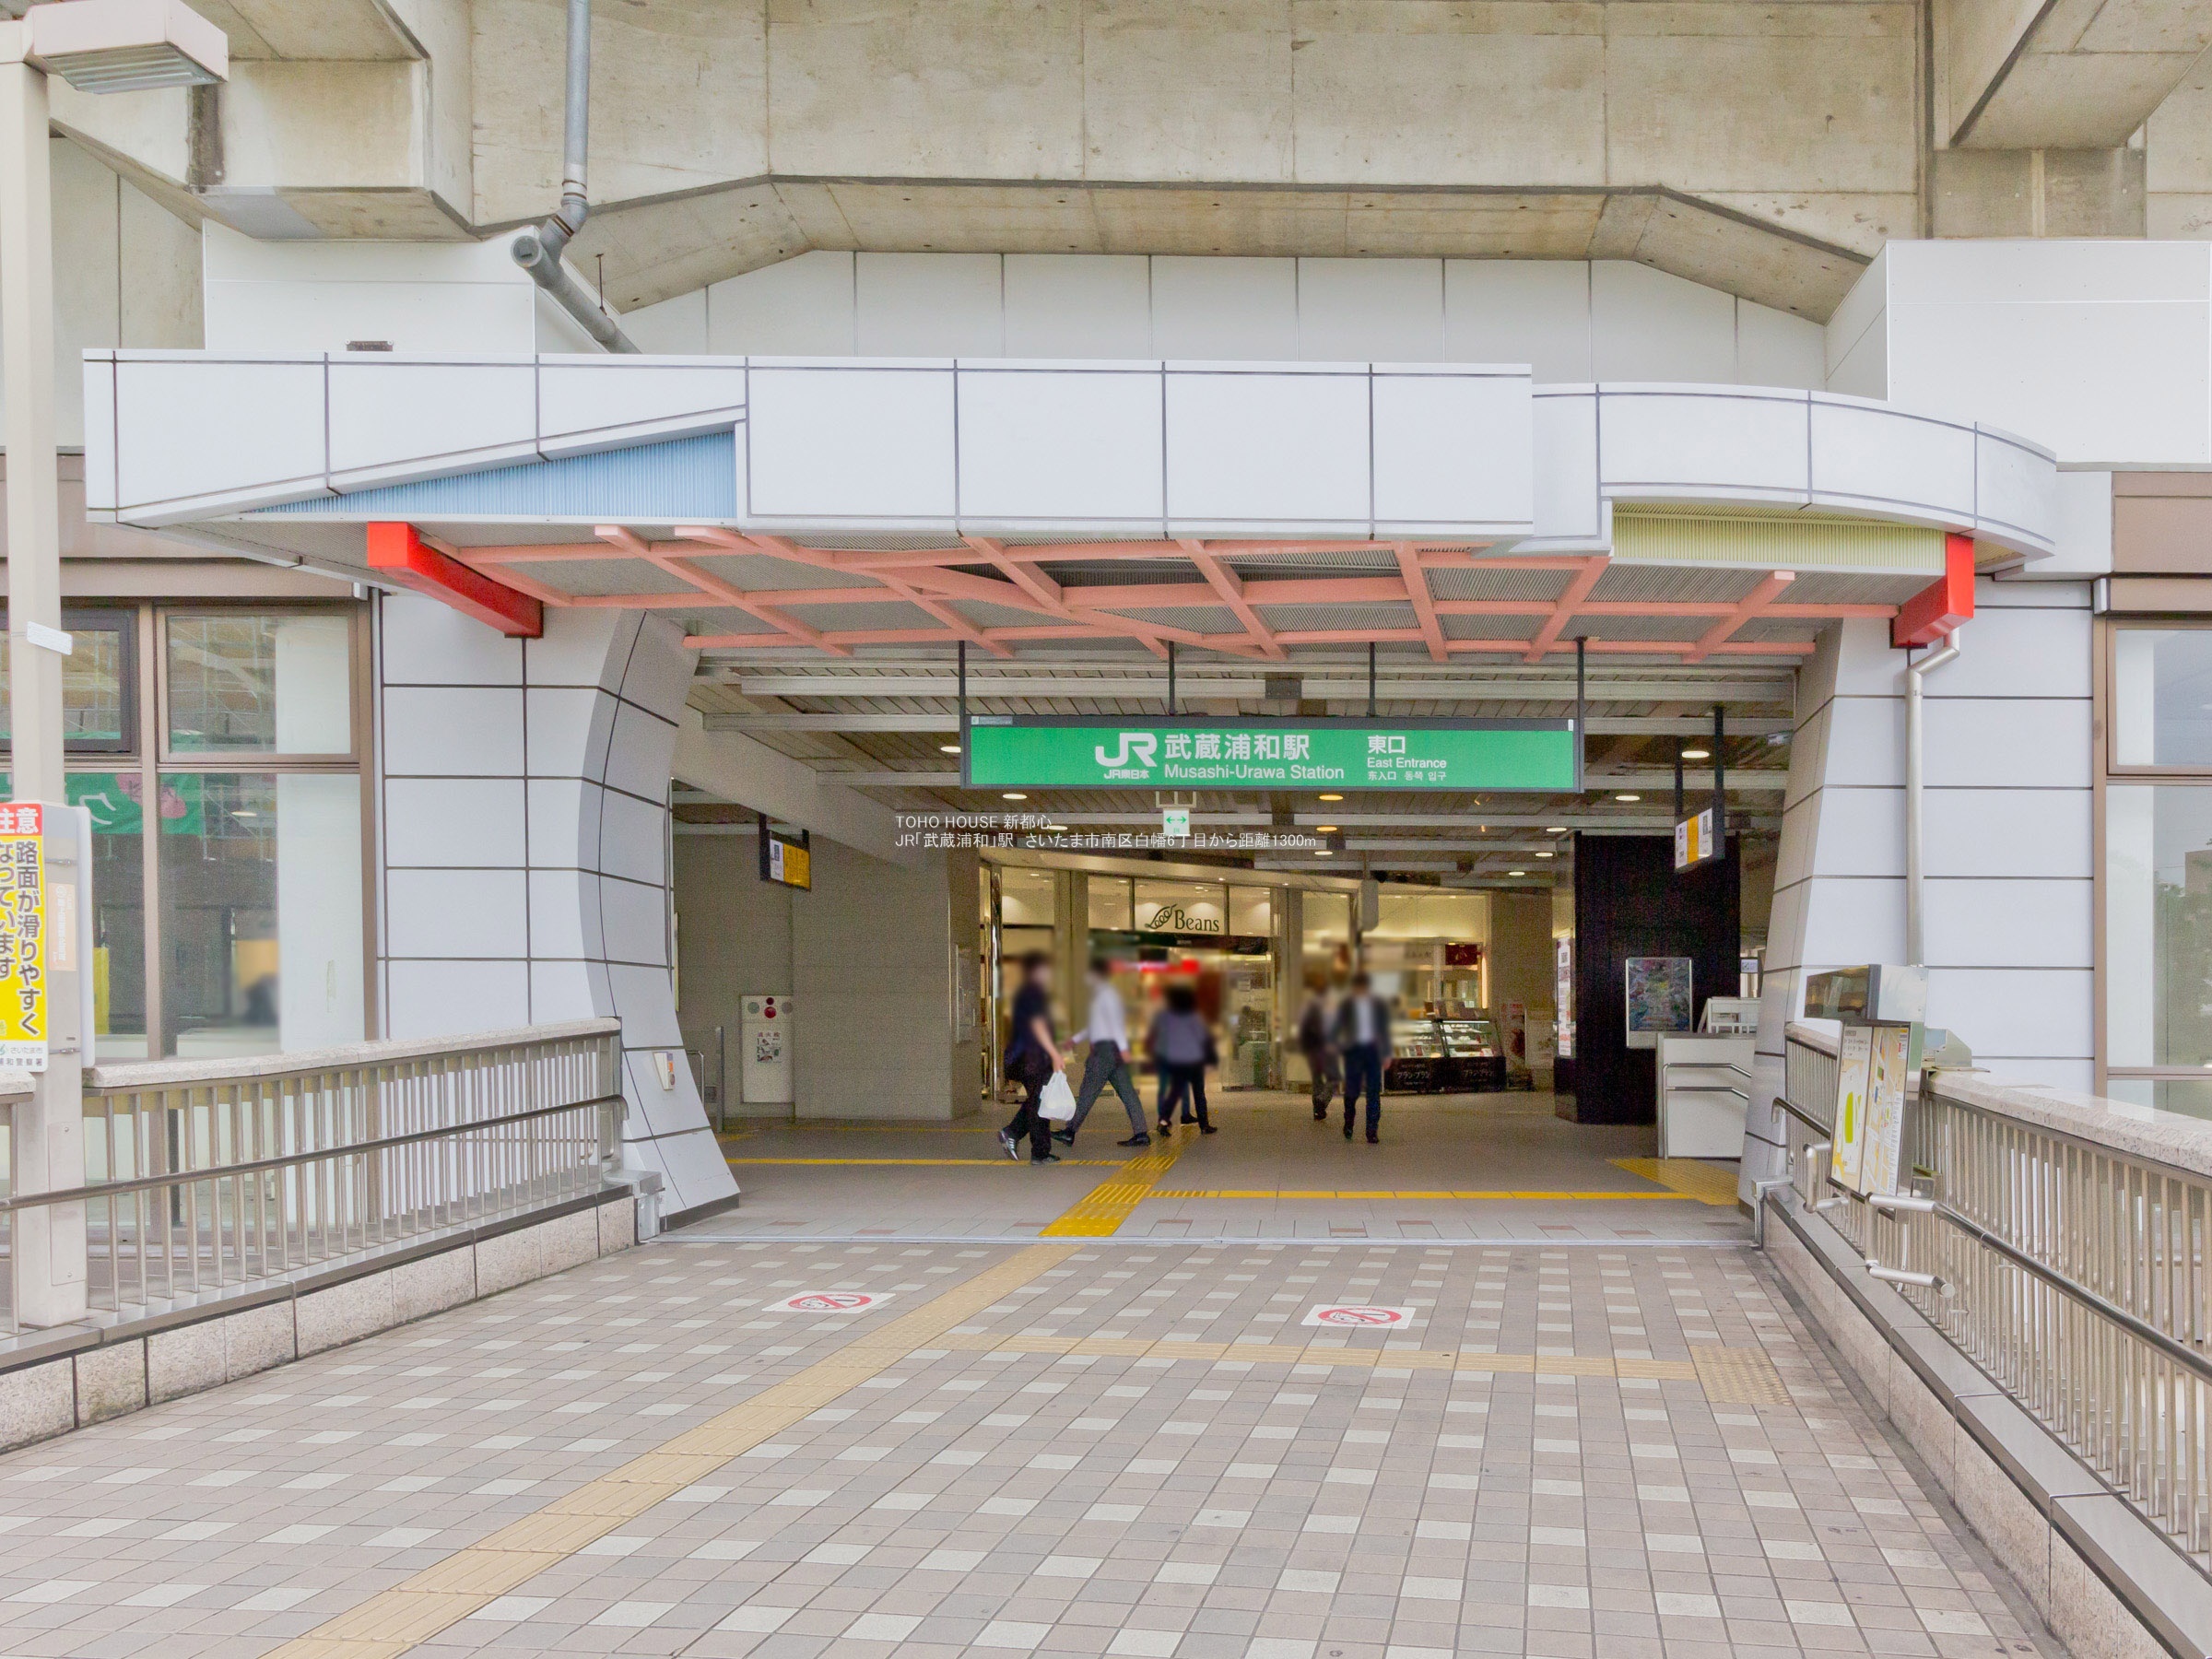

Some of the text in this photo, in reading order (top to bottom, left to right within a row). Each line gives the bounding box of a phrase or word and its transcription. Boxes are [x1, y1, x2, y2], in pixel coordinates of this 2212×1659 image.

[1095, 732, 1158, 767] JR
[1164, 734, 1310, 760] 武蔵浦和駅
[1368, 735, 1406, 754] 東口
[1367, 757, 1447, 769] East Entrance
[1103, 769, 1149, 780] JR東日本
[1164, 764, 1345, 780] Musashi-Urawa Station
[1368, 771, 1397, 781] 东入口
[1429, 771, 1447, 782] 입구
[1174, 909, 1219, 932] Beans
[17, 841, 41, 1035] 路面が滑りやすく
